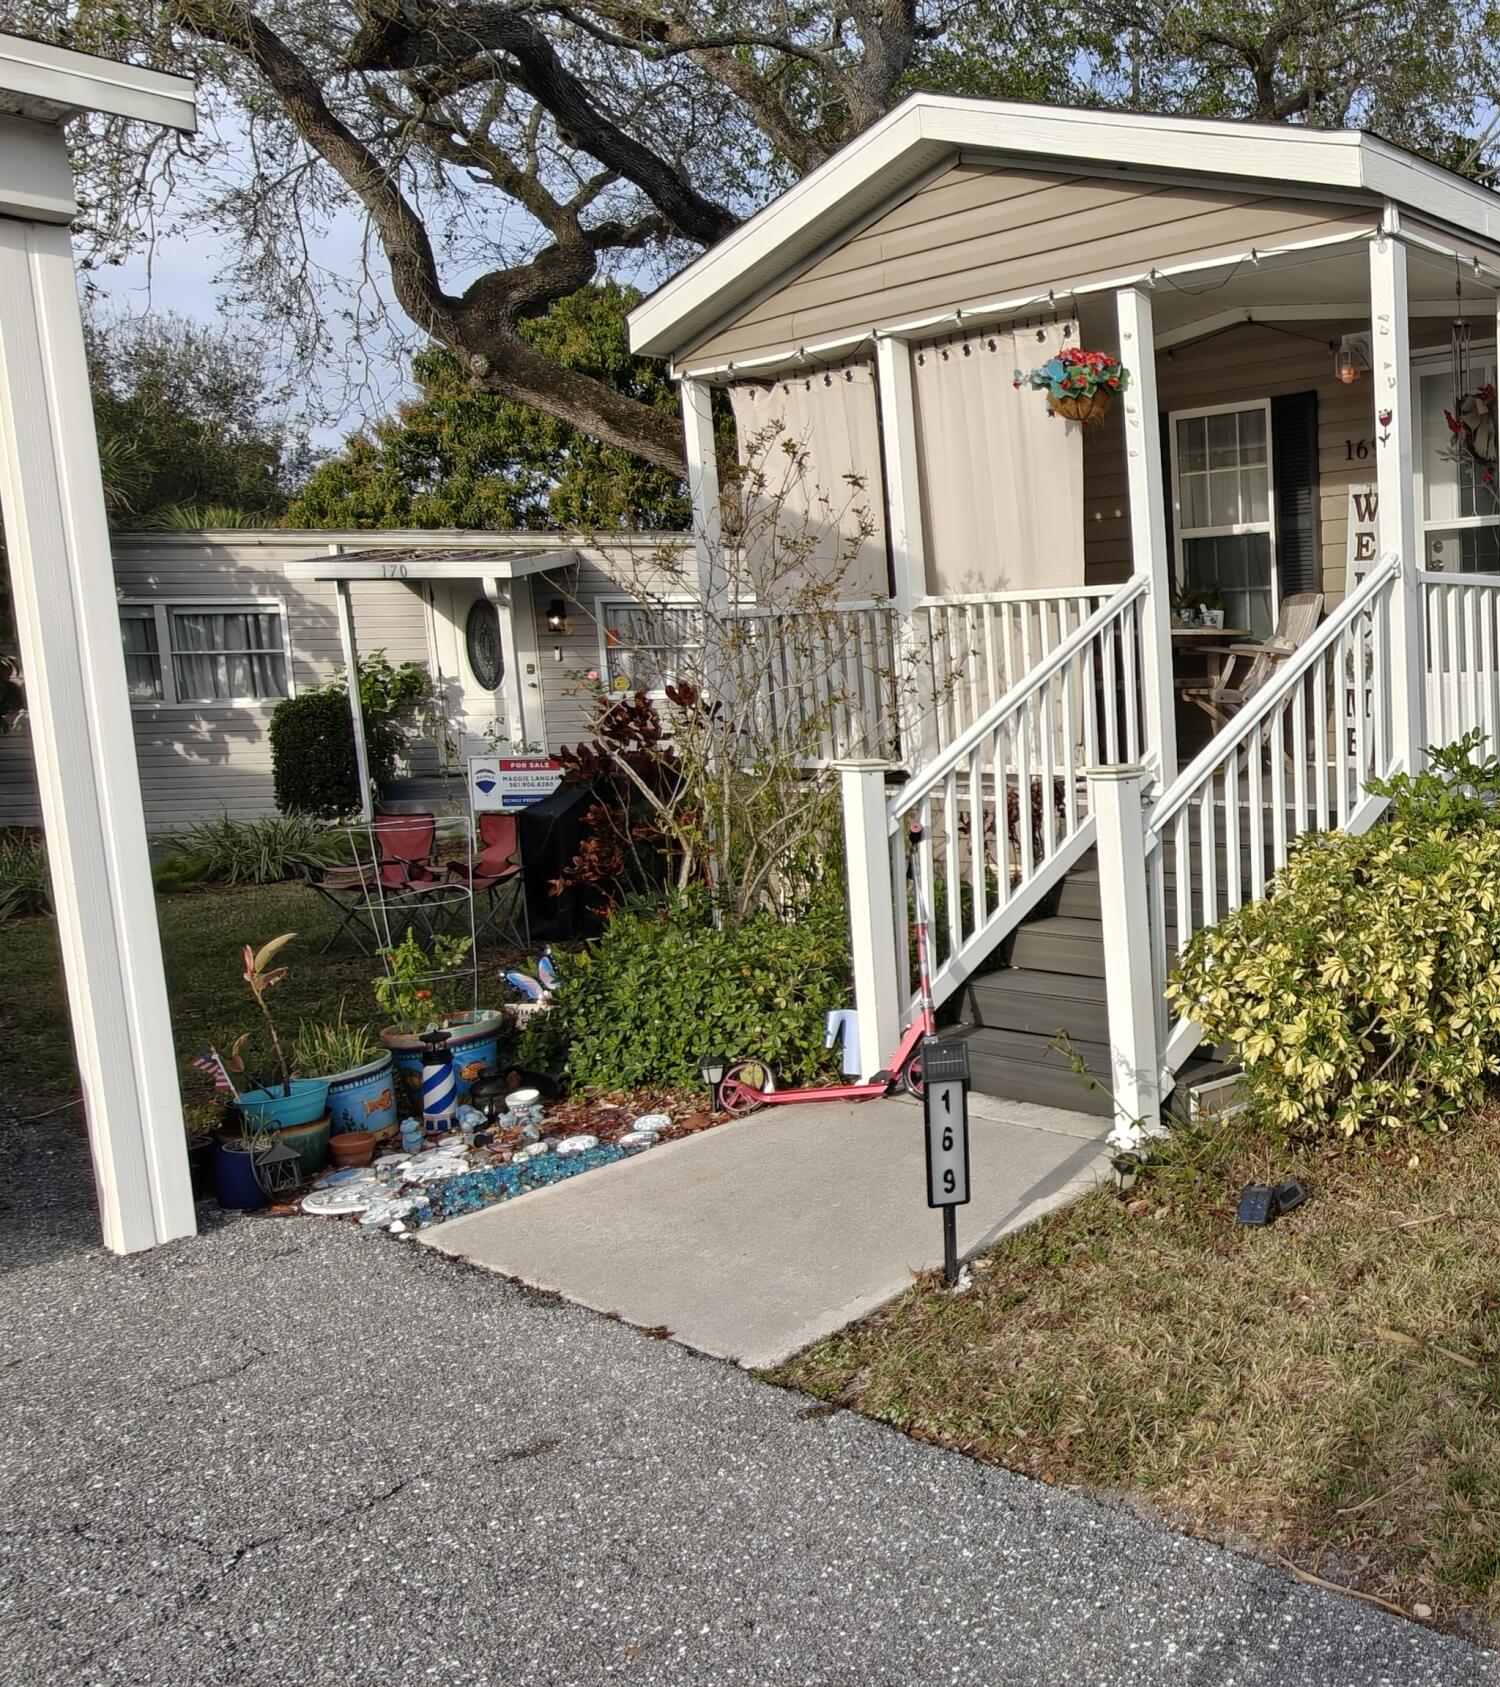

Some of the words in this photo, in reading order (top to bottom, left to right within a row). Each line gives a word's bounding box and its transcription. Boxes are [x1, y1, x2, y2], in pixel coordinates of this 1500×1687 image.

[1344, 438, 1376, 461] 16
[382, 564, 408, 578] 170
[940, 1088, 957, 1195] 169
